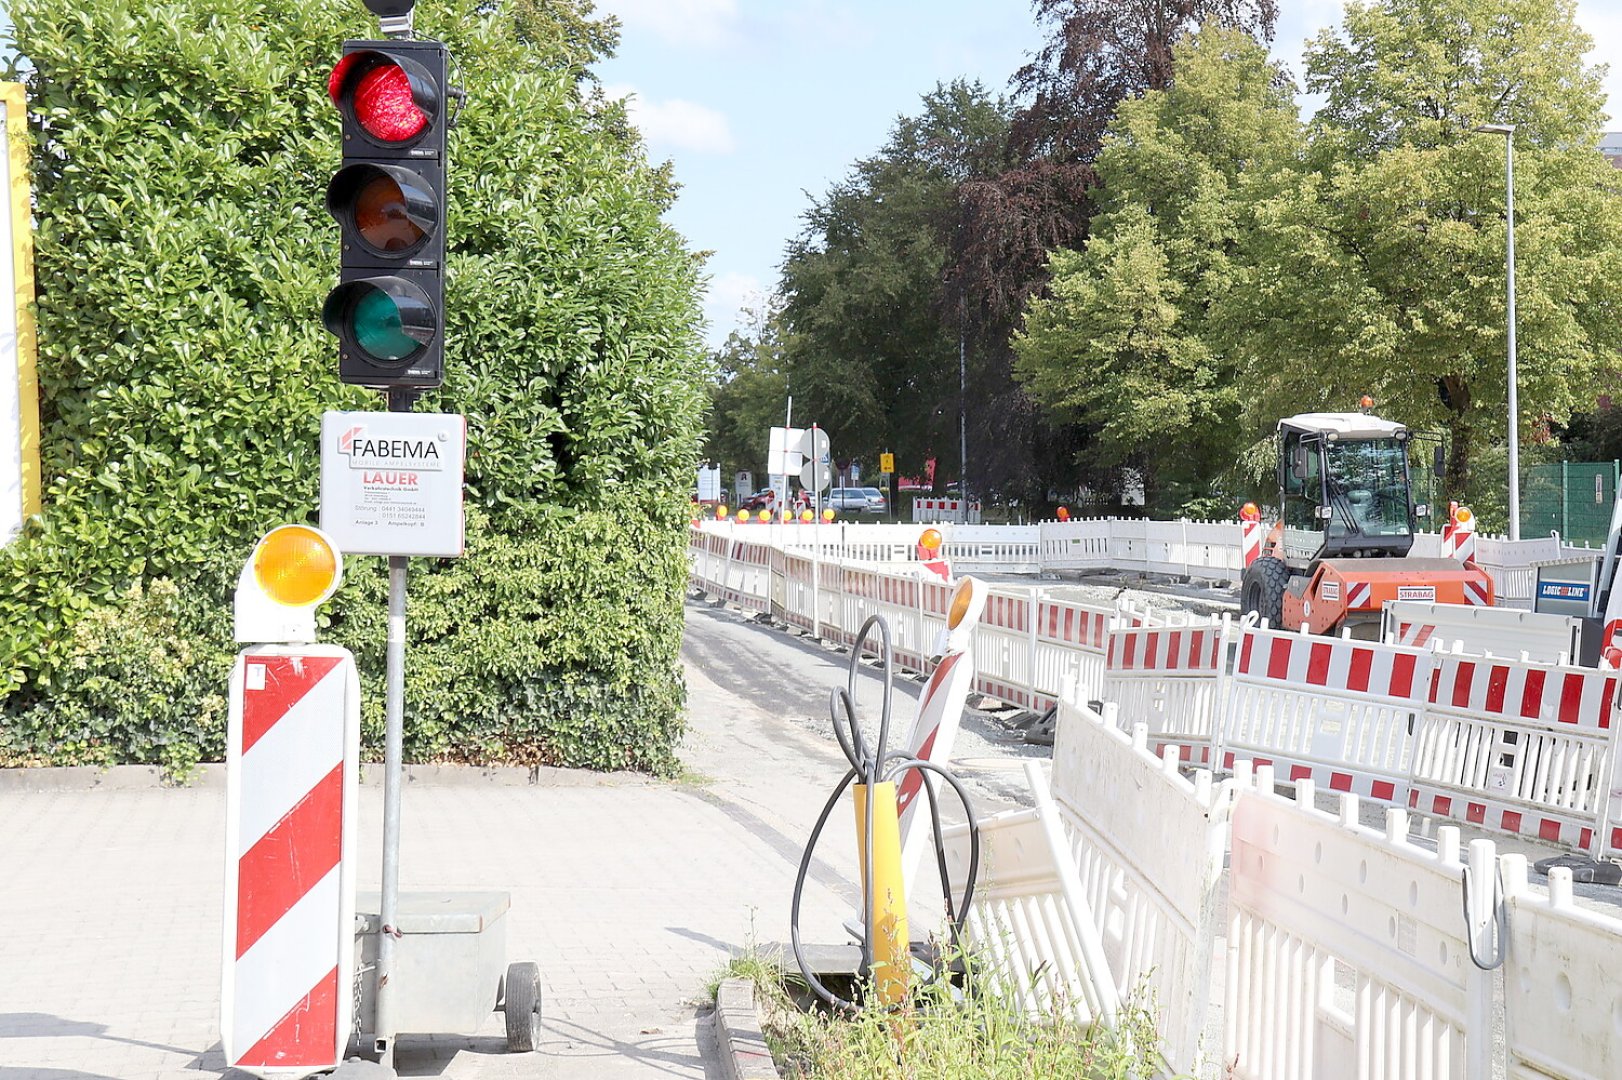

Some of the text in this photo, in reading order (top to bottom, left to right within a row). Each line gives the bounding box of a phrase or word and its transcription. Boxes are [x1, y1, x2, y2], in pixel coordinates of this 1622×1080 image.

[353, 439, 439, 459] FABEMA
[363, 472, 418, 485] LAUER
[1399, 591, 1434, 599] STRABAG
[1542, 585, 1562, 596] LOGIC
